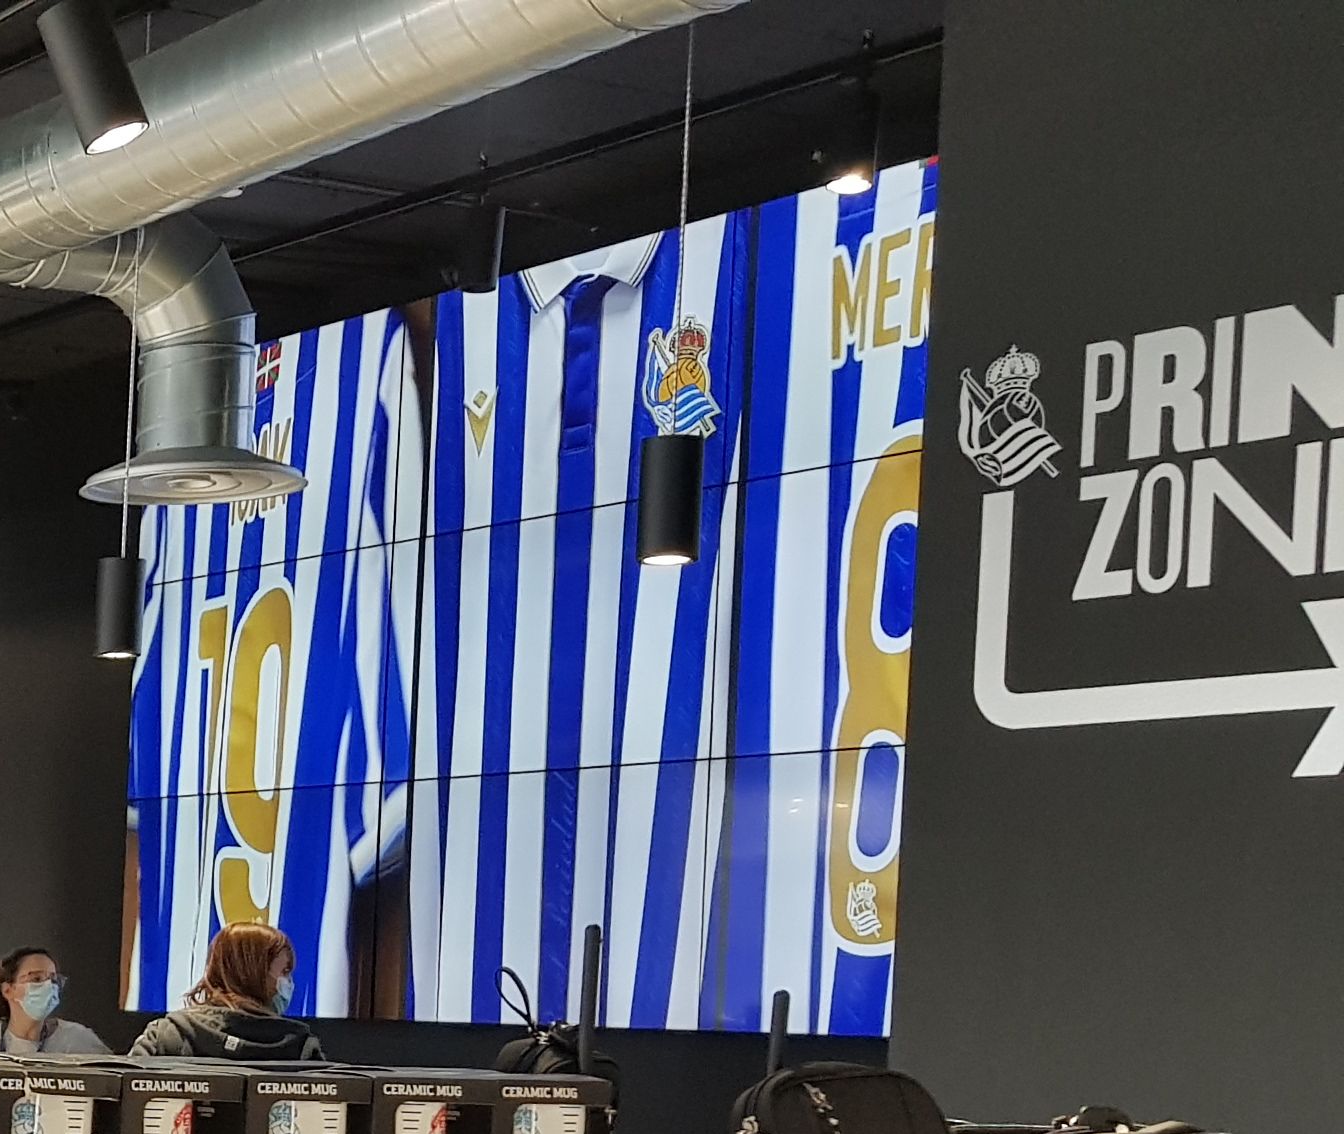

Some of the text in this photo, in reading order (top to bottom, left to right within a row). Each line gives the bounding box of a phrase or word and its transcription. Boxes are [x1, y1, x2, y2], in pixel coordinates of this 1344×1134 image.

[1072, 437, 1344, 601] ZON
[58, 1079, 86, 1091] MUG
[131, 1080, 210, 1093] CERAMIC MUG
[257, 1082, 338, 1095] CERAMIC MUG
[383, 1084, 463, 1097] CERAMIC MUG
[502, 1086, 578, 1099] CERAMIC MUG
